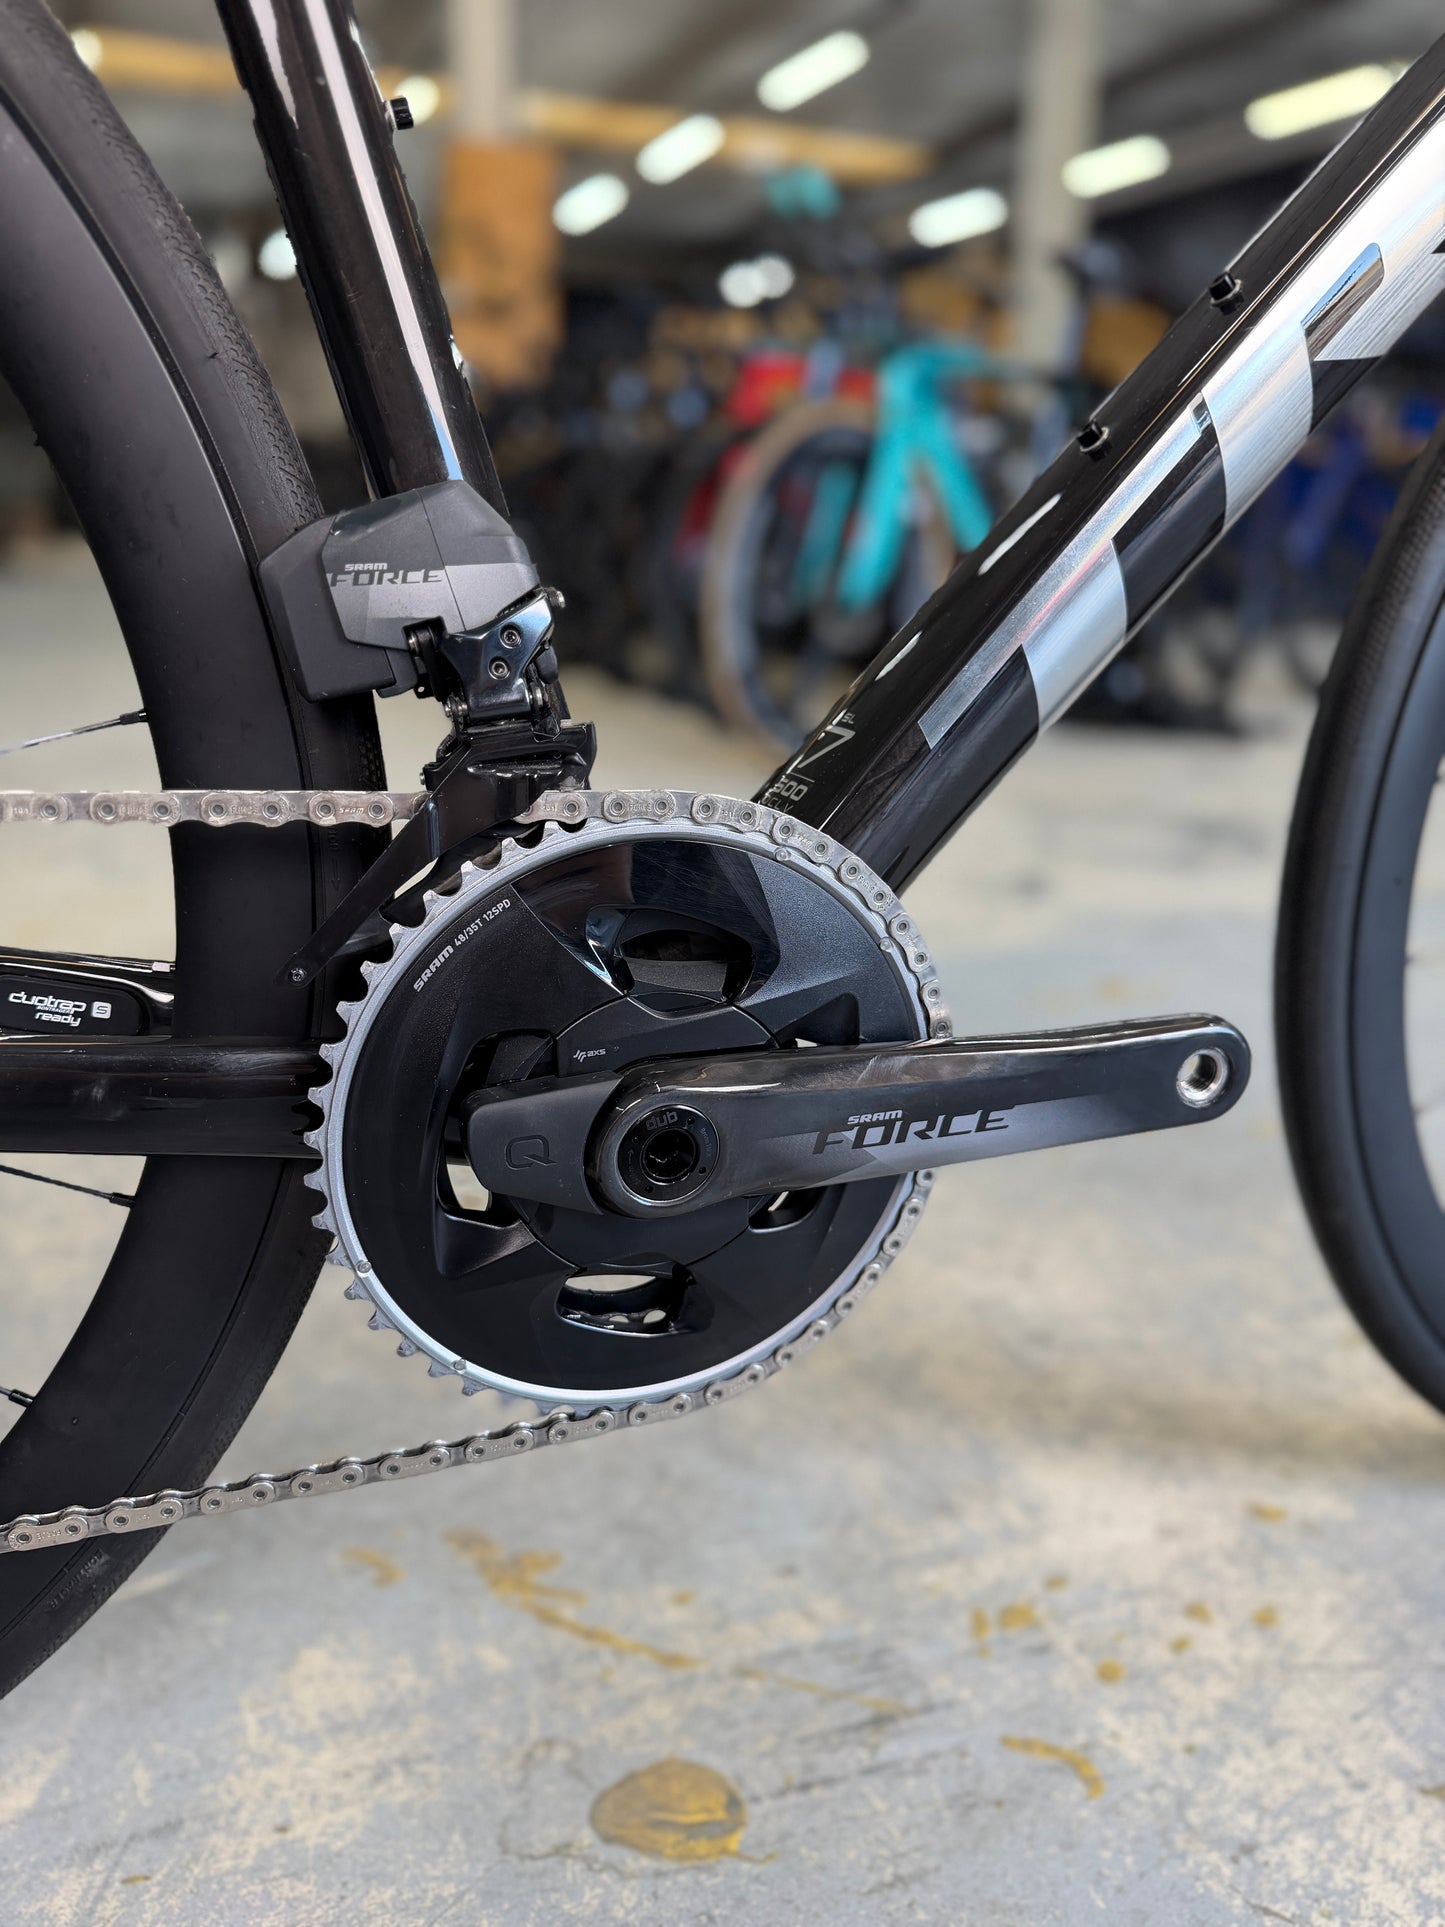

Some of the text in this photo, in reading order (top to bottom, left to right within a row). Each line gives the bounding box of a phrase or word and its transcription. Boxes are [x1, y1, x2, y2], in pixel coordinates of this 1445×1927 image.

[344, 562, 388, 571] SRAM
[329, 568, 443, 588] FORCE
[413, 898, 512, 992] SRAM 48/35T 12SPD
[8, 991, 87, 1015] duotrap
[35, 1011, 81, 1027] ready
[587, 1048, 606, 1057] axs
[847, 1109, 903, 1125] SRAM
[812, 1108, 1009, 1155] FORCE
